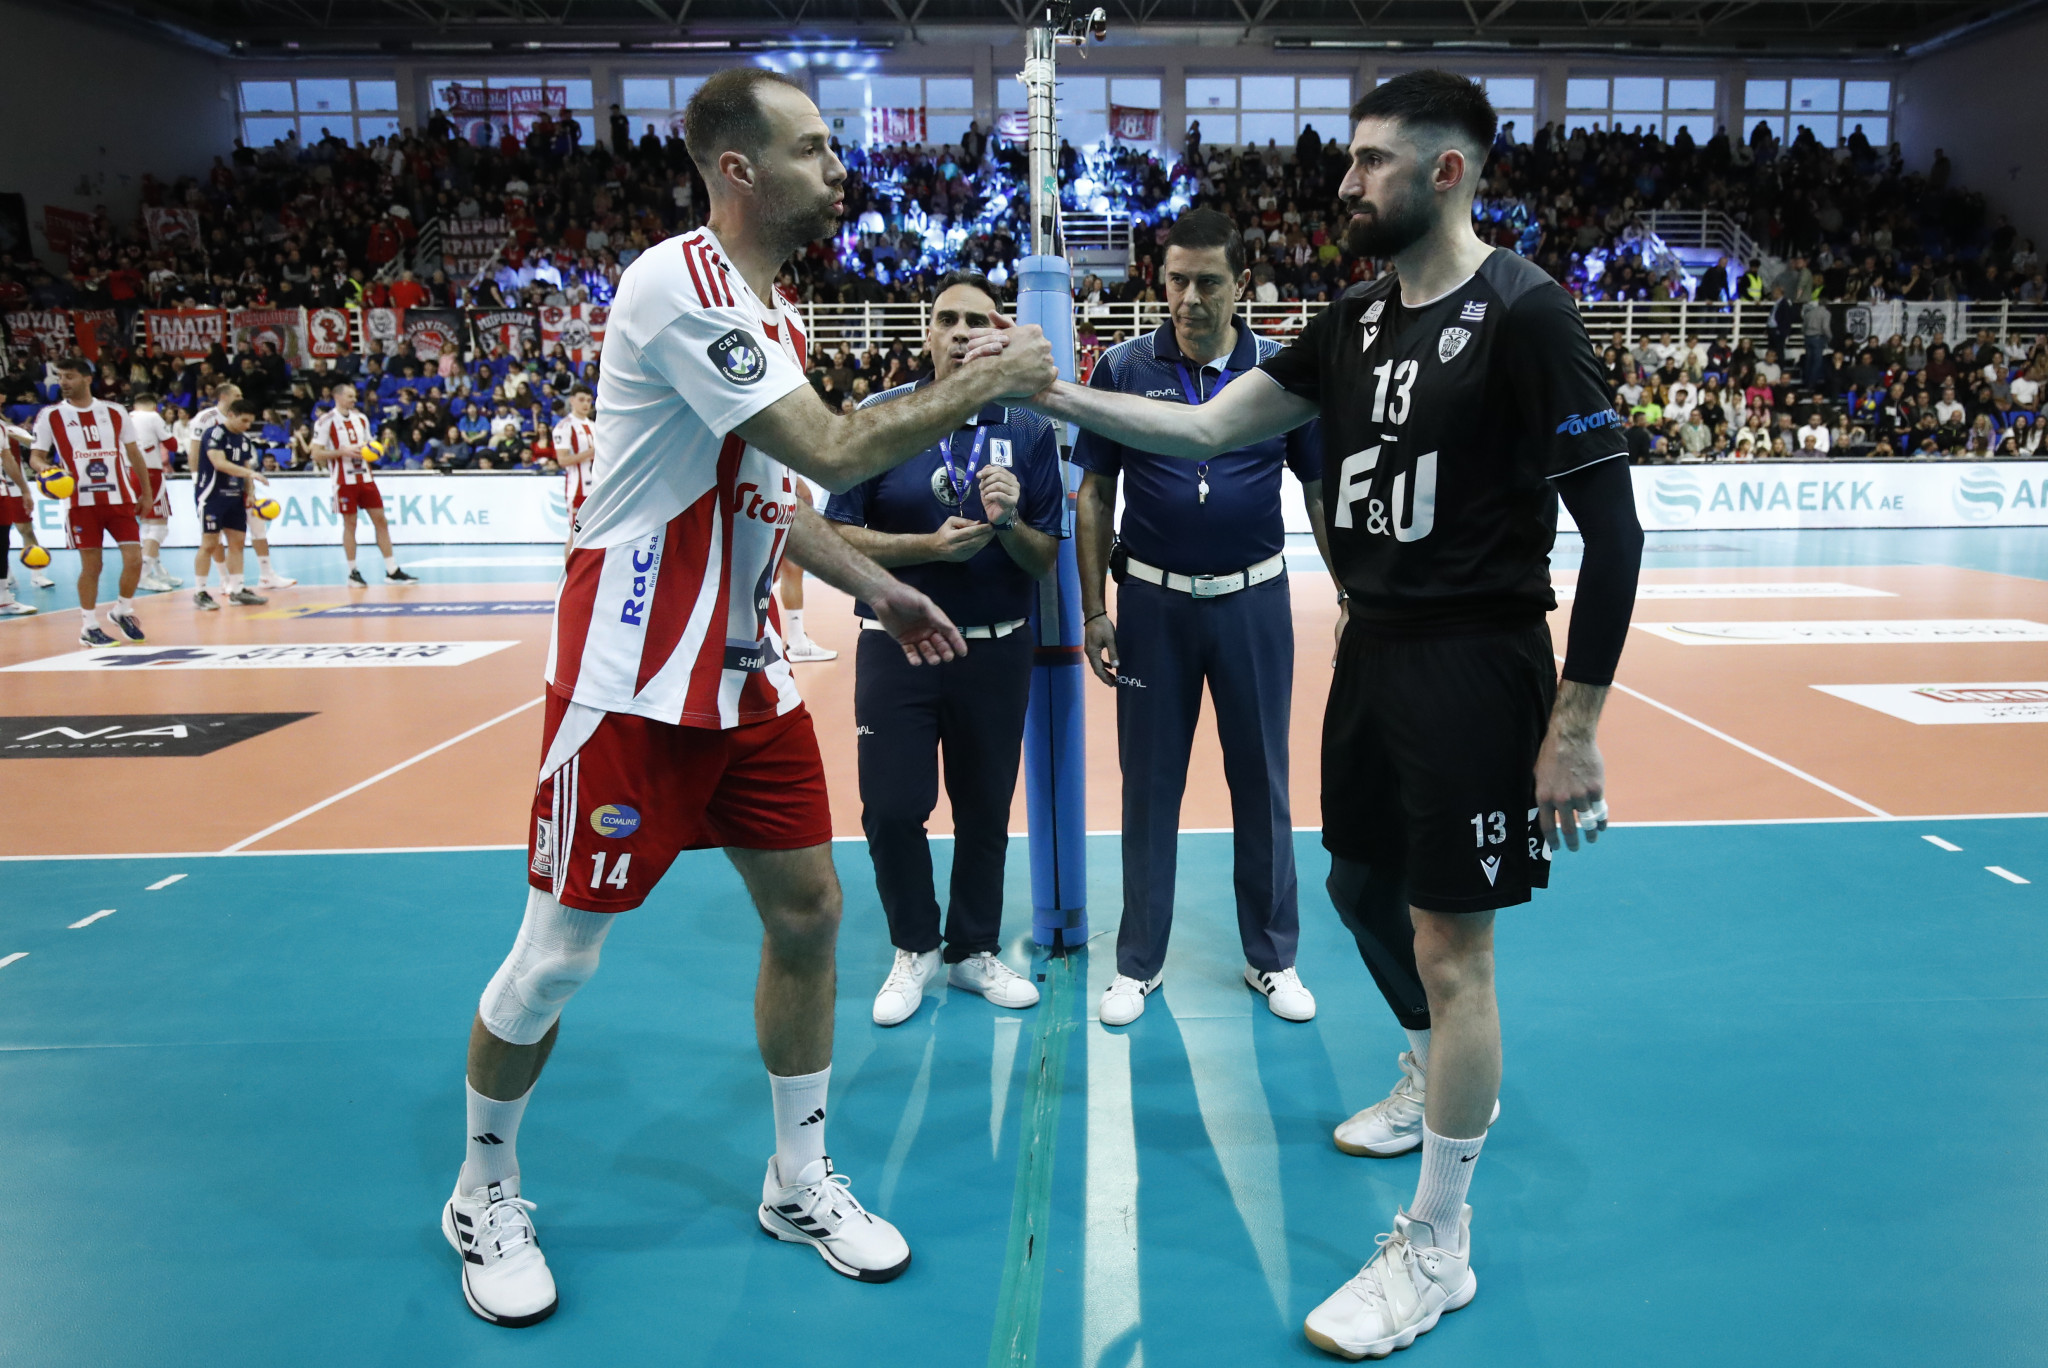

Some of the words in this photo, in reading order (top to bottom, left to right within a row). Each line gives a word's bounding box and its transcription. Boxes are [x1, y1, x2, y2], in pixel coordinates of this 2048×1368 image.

[150, 314, 223, 335] ΓΑΛΑΤΣΙ
[1444, 328, 1469, 338] ΠΑΟΚ
[718, 333, 738, 351] CEV
[1145, 388, 1180, 397] ROYAL
[1370, 358, 1419, 425] 13
[83, 425, 100, 442] 19
[1334, 444, 1438, 543] F&U
[1708, 480, 1874, 512] ANAEKK
[1879, 495, 1904, 511] AE
[463, 510, 490, 525] AE
[620, 550, 654, 626] RaC
[602, 816, 638, 827] COMLINE
[1470, 810, 1507, 848] 13
[590, 851, 632, 890] 14
